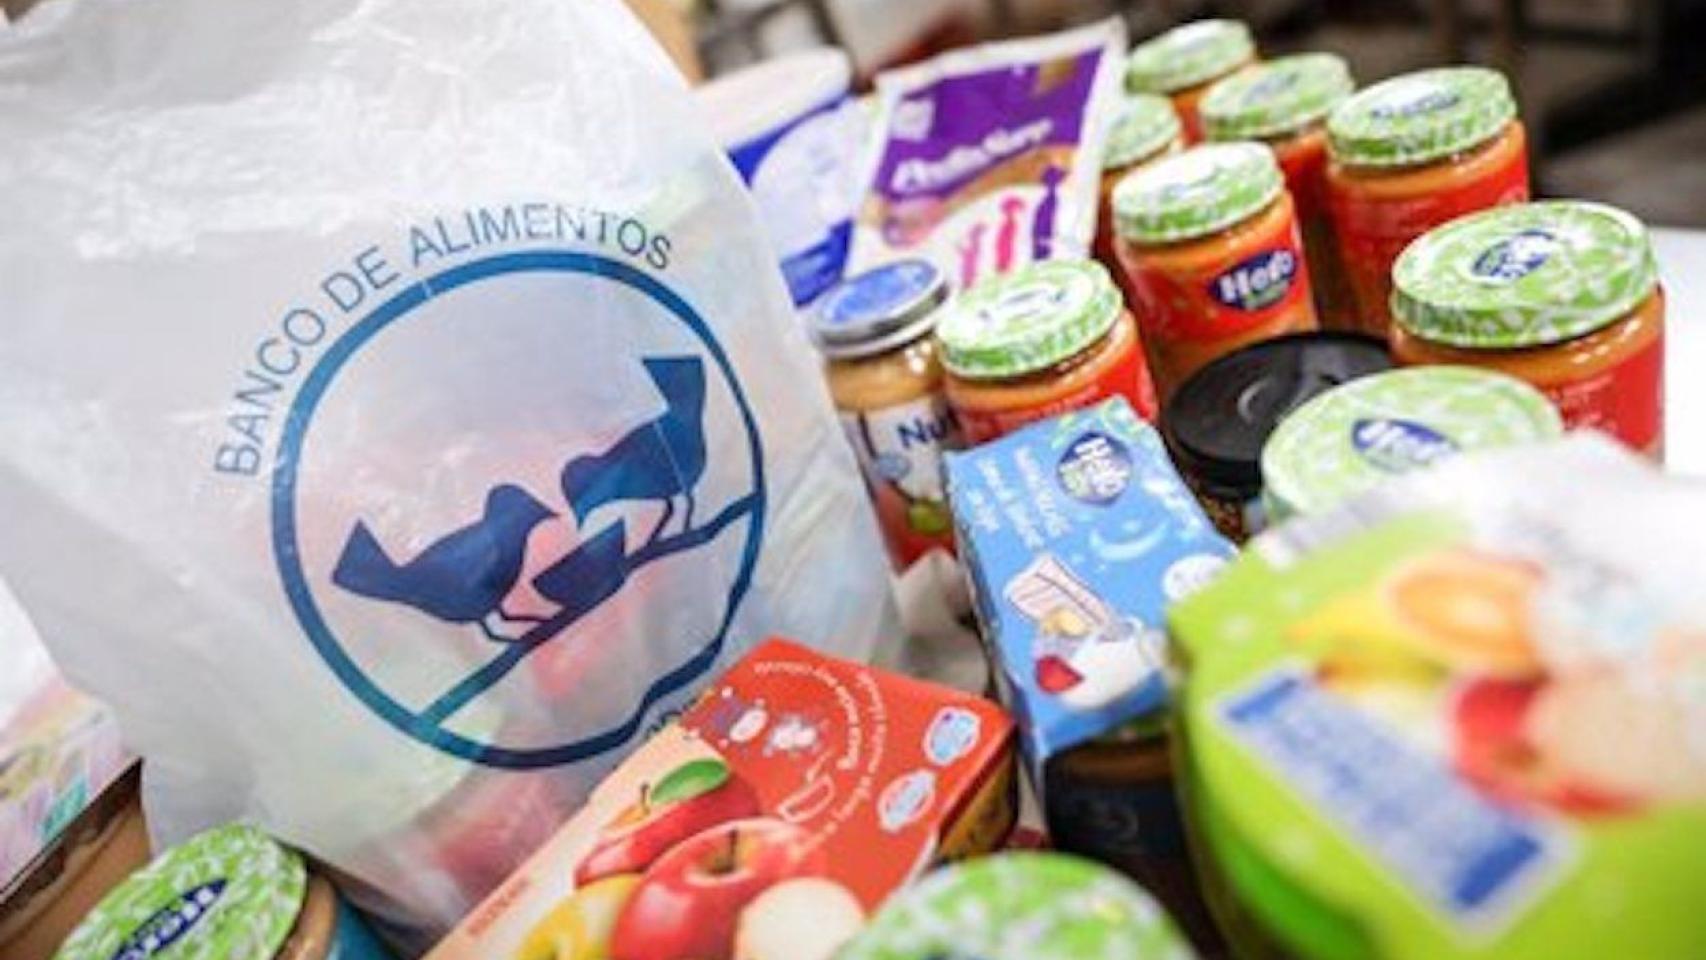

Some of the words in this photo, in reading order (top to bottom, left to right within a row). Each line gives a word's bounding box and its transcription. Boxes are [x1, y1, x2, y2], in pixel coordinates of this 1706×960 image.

[214, 306, 327, 475] BANCO
[321, 245, 401, 313] DE
[409, 203, 673, 270] ALIMENTOS
